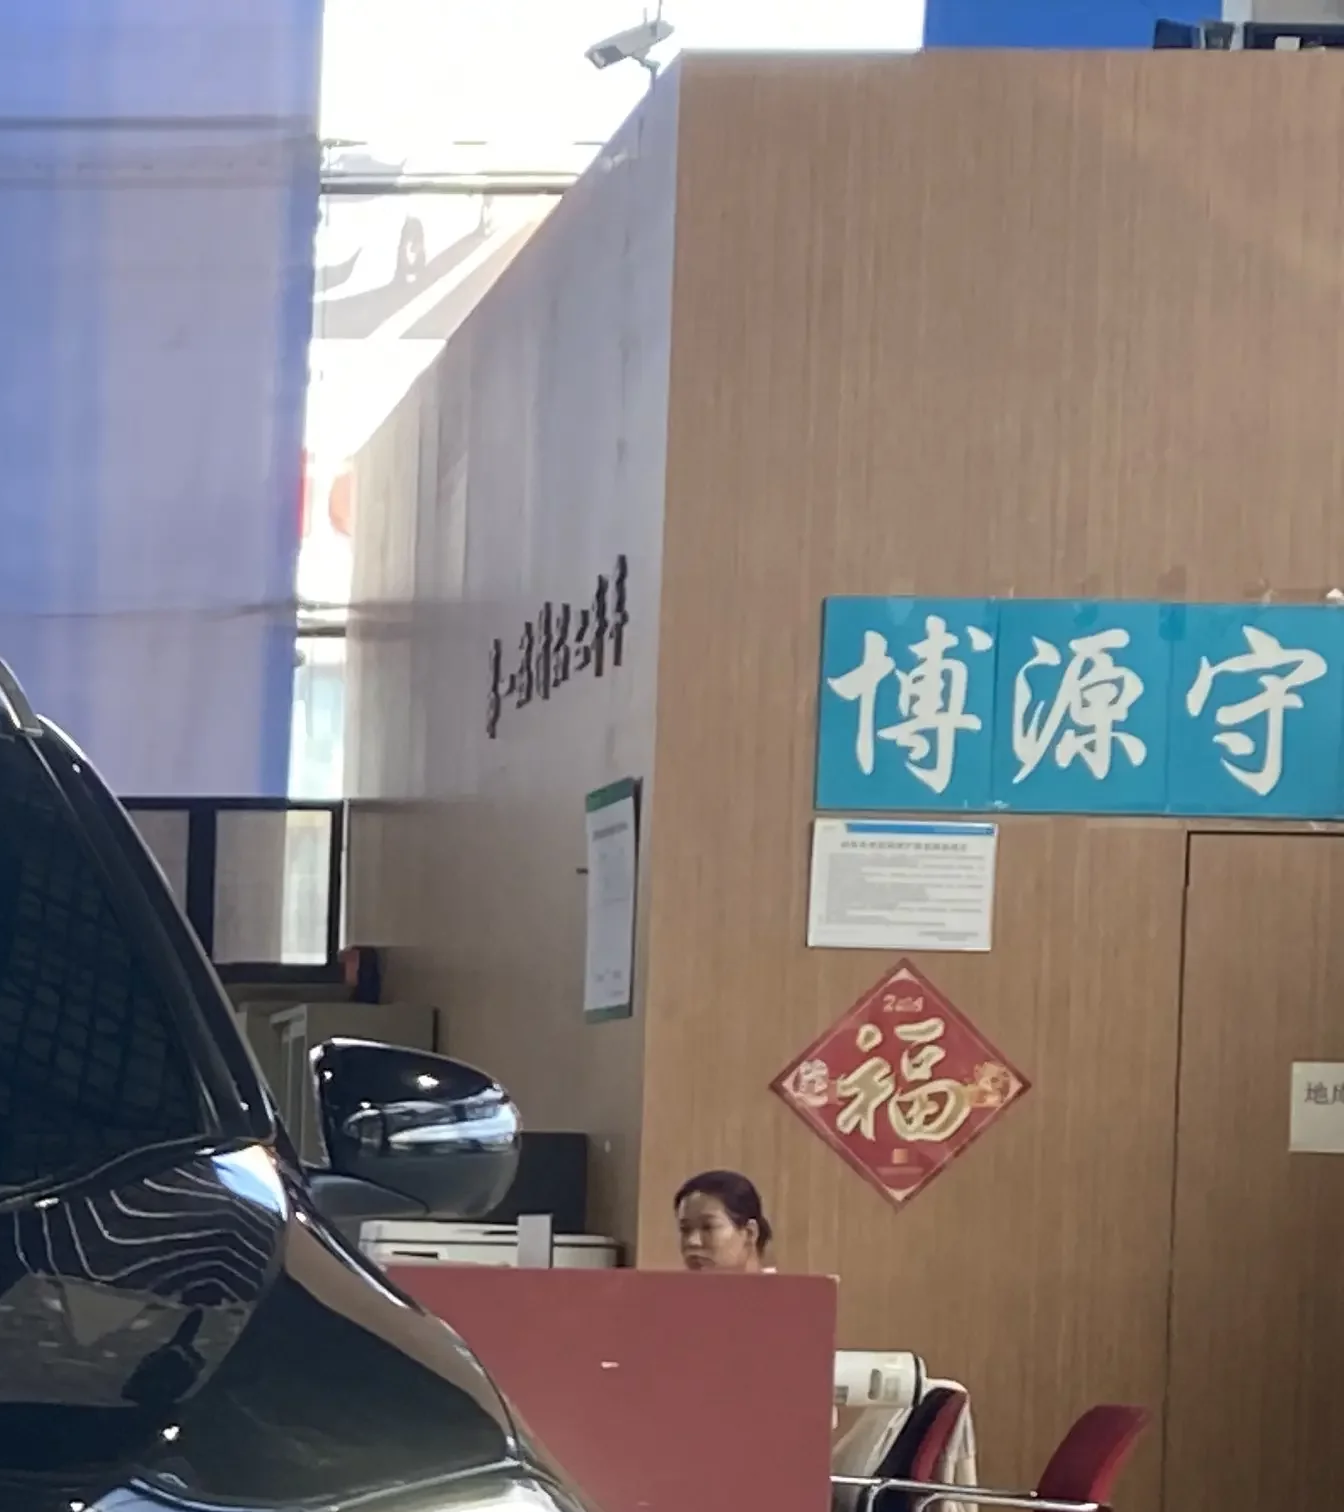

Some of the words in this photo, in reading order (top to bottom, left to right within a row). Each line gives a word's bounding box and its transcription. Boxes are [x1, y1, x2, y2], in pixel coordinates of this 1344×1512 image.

[826, 615, 1328, 796] 博源守
[836, 1017, 971, 1142] 福
